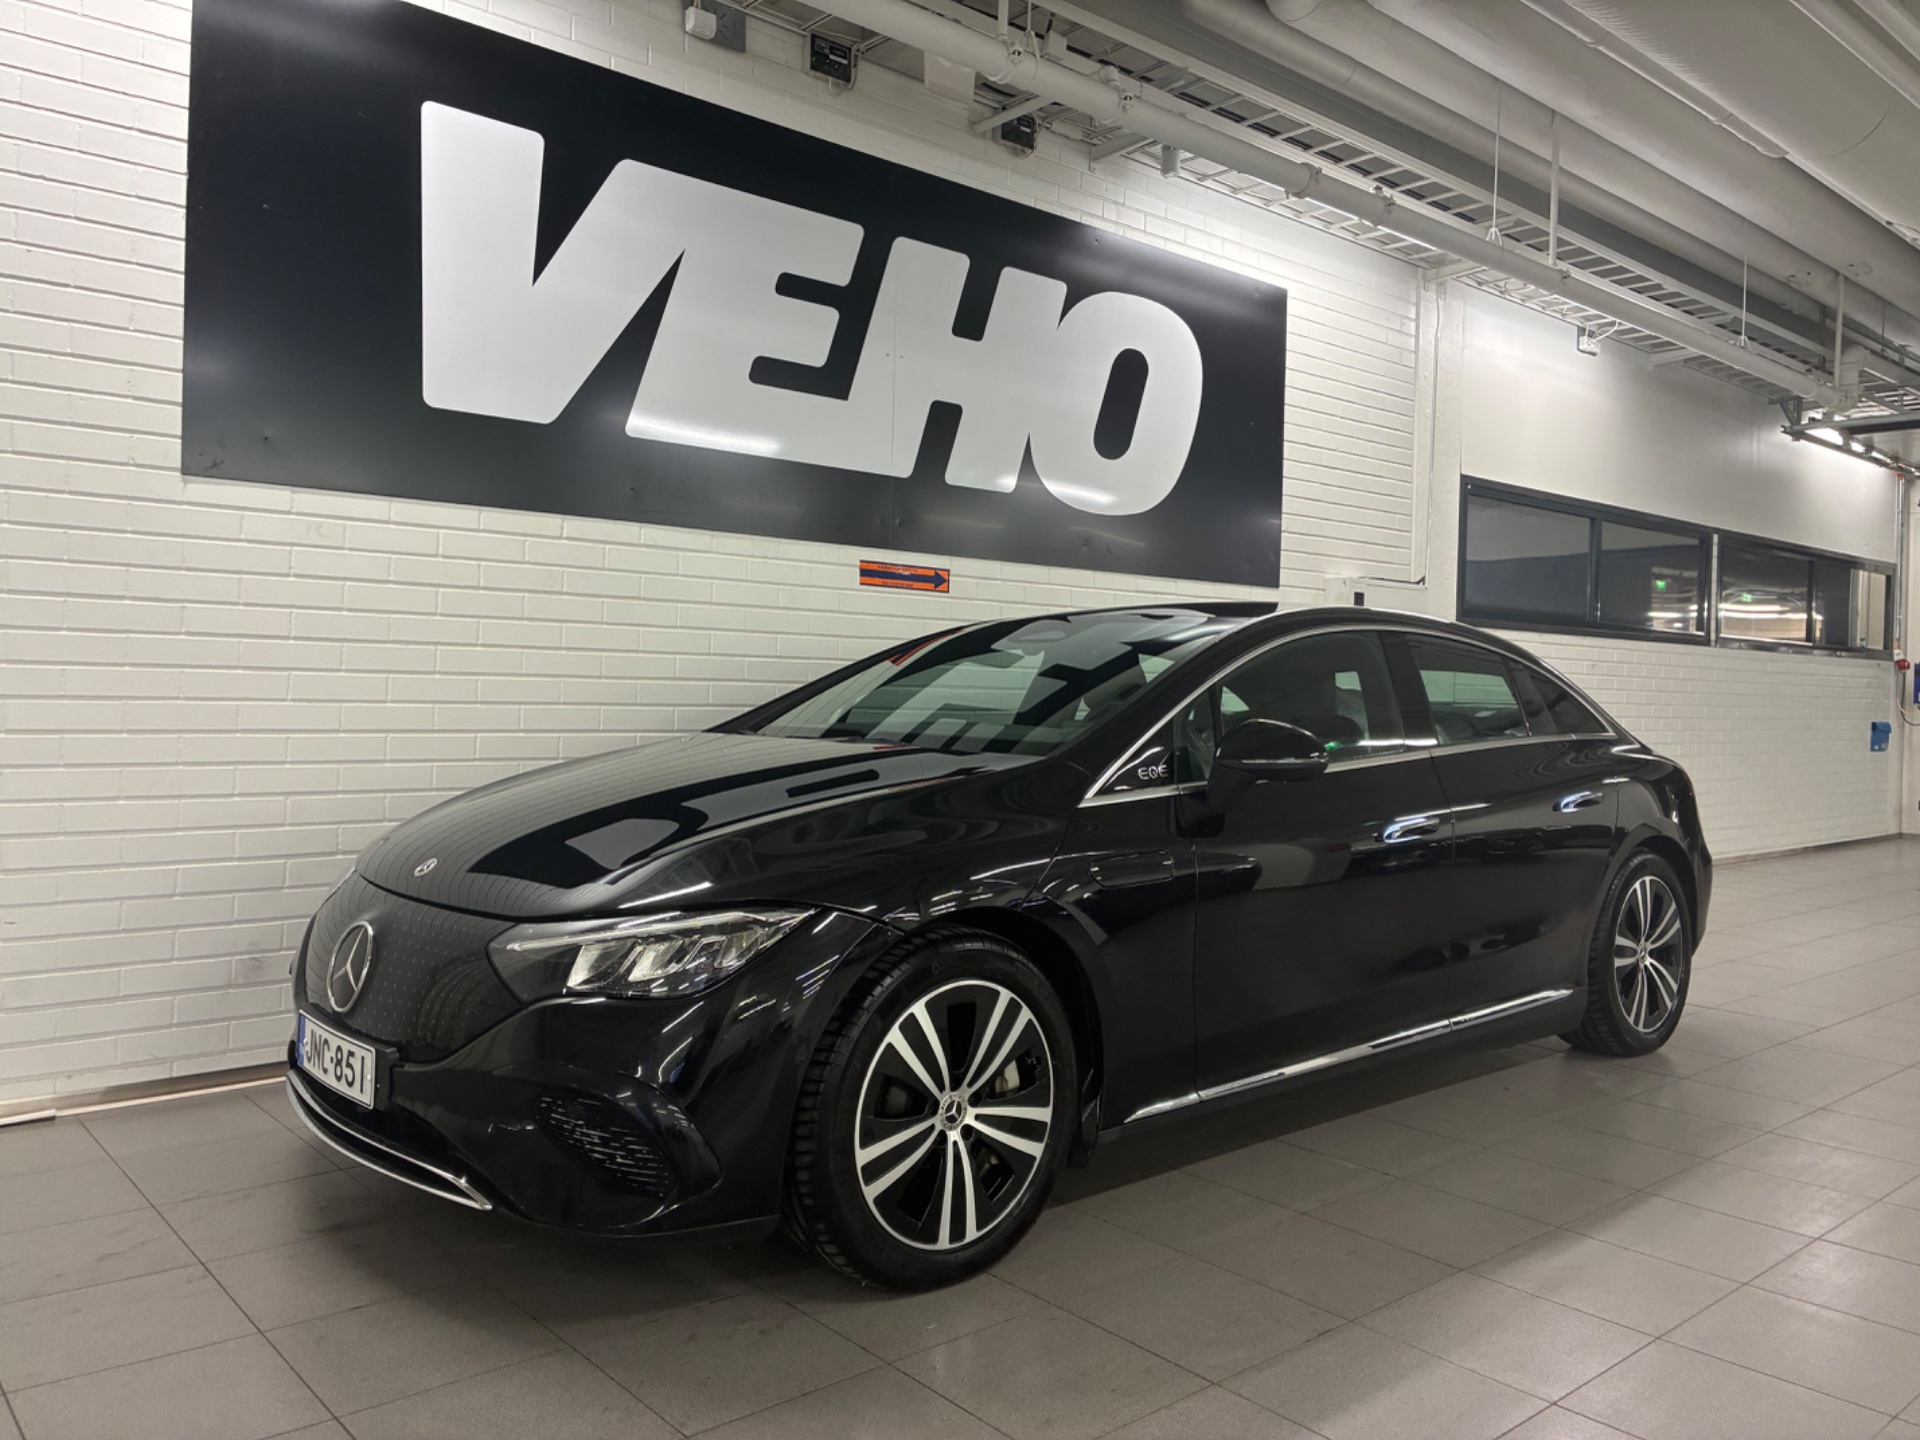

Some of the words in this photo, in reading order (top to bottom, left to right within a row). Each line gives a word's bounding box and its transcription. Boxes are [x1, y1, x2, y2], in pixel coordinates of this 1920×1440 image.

[421, 101, 1203, 516] VEHO
[1138, 764, 1169, 781] EQE
[305, 1028, 365, 1094] JNC-851
